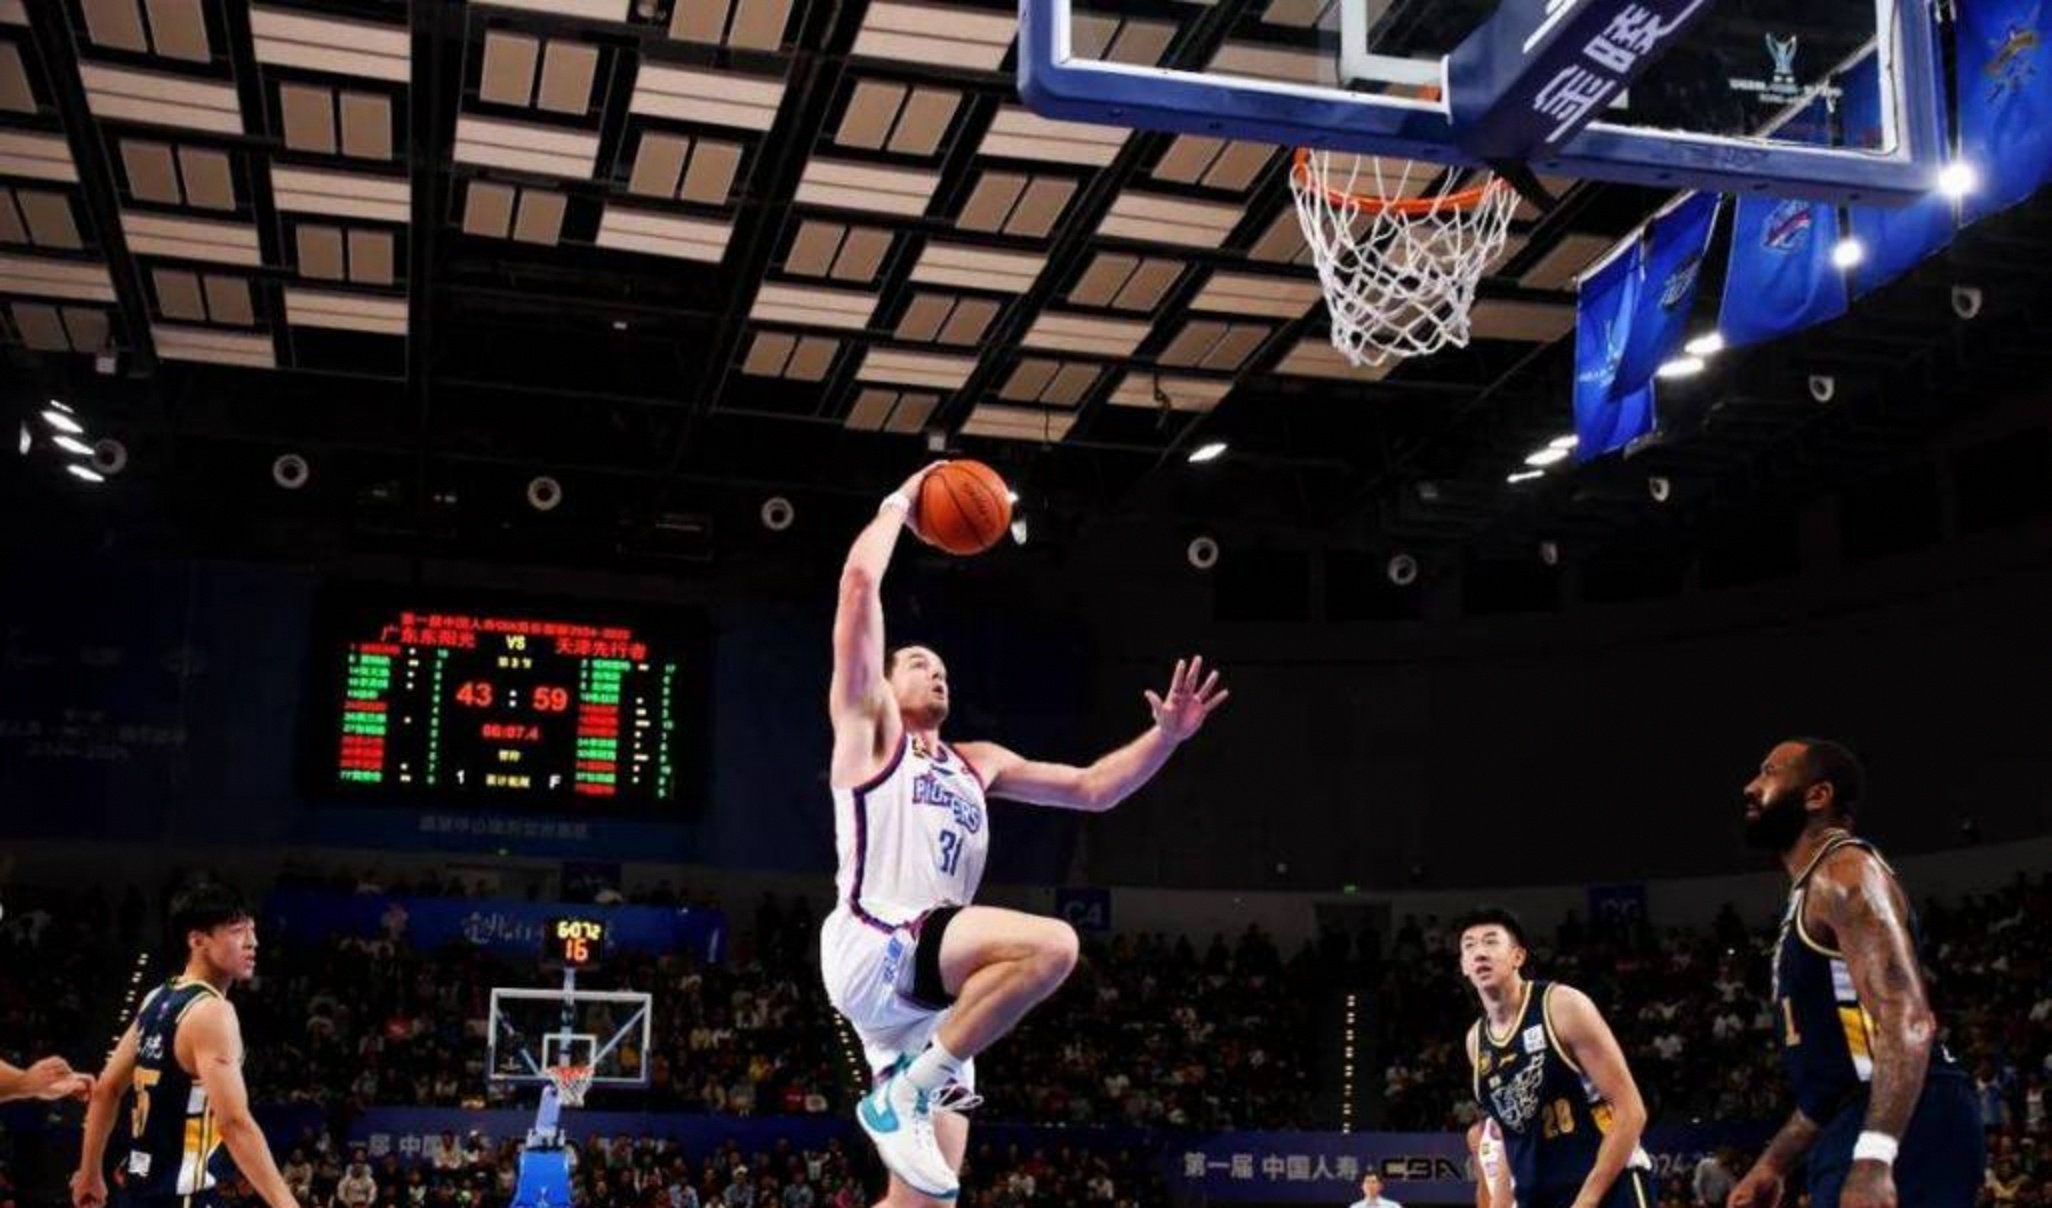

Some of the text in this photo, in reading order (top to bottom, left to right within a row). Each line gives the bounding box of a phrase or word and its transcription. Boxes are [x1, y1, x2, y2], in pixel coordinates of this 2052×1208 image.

[1532, 2, 1690, 144] 金陵
[504, 634, 526, 651] VS
[455, 682, 568, 712] 43 59
[938, 829, 963, 877] 31
[564, 937, 590, 963] 16
[1184, 1150, 1254, 1180] 第一届
[1262, 1153, 1359, 1182] 中国人寿
[1380, 1156, 1463, 1182] CBA
